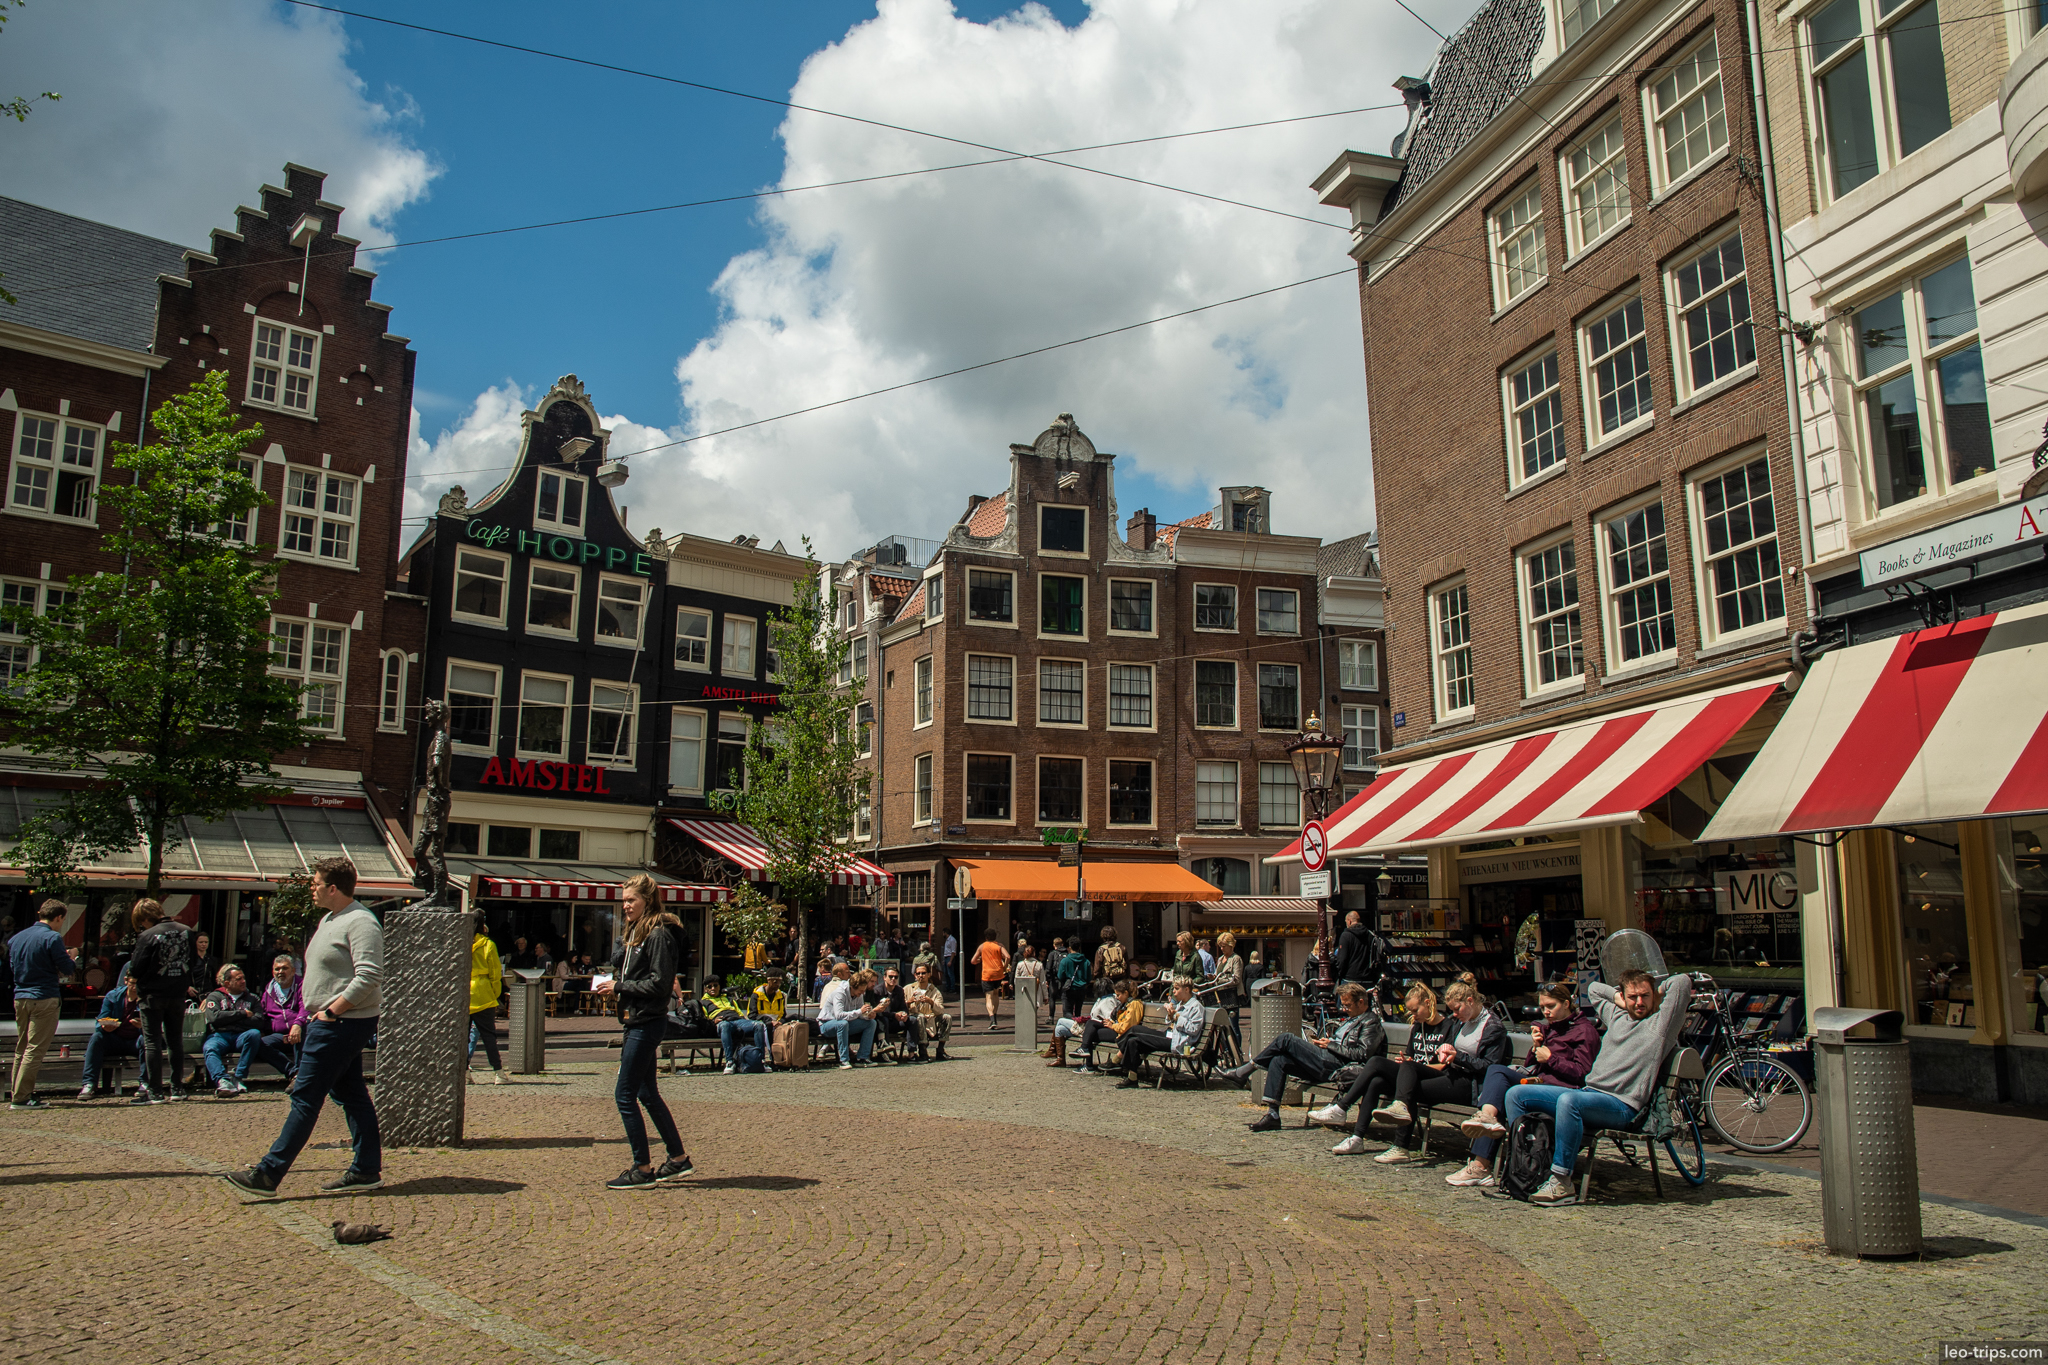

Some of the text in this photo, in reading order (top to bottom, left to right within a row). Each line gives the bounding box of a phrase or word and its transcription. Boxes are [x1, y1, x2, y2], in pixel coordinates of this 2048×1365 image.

[465, 518, 652, 576] Café HOPPE
[1878, 552, 1909, 576] Books
[1912, 547, 1926, 565] &
[1928, 533, 1994, 561] Magazines
[701, 685, 777, 705] AMSTEL BIER
[479, 756, 611, 794] AMSTEL
[320, 797, 345, 805] Jupiler
[1461, 862, 1509, 877] ATHENAEUM
[1391, 874, 1413, 883] UTCH
[1093, 892, 1103, 900] de
[1105, 892, 1128, 900] Zwart
